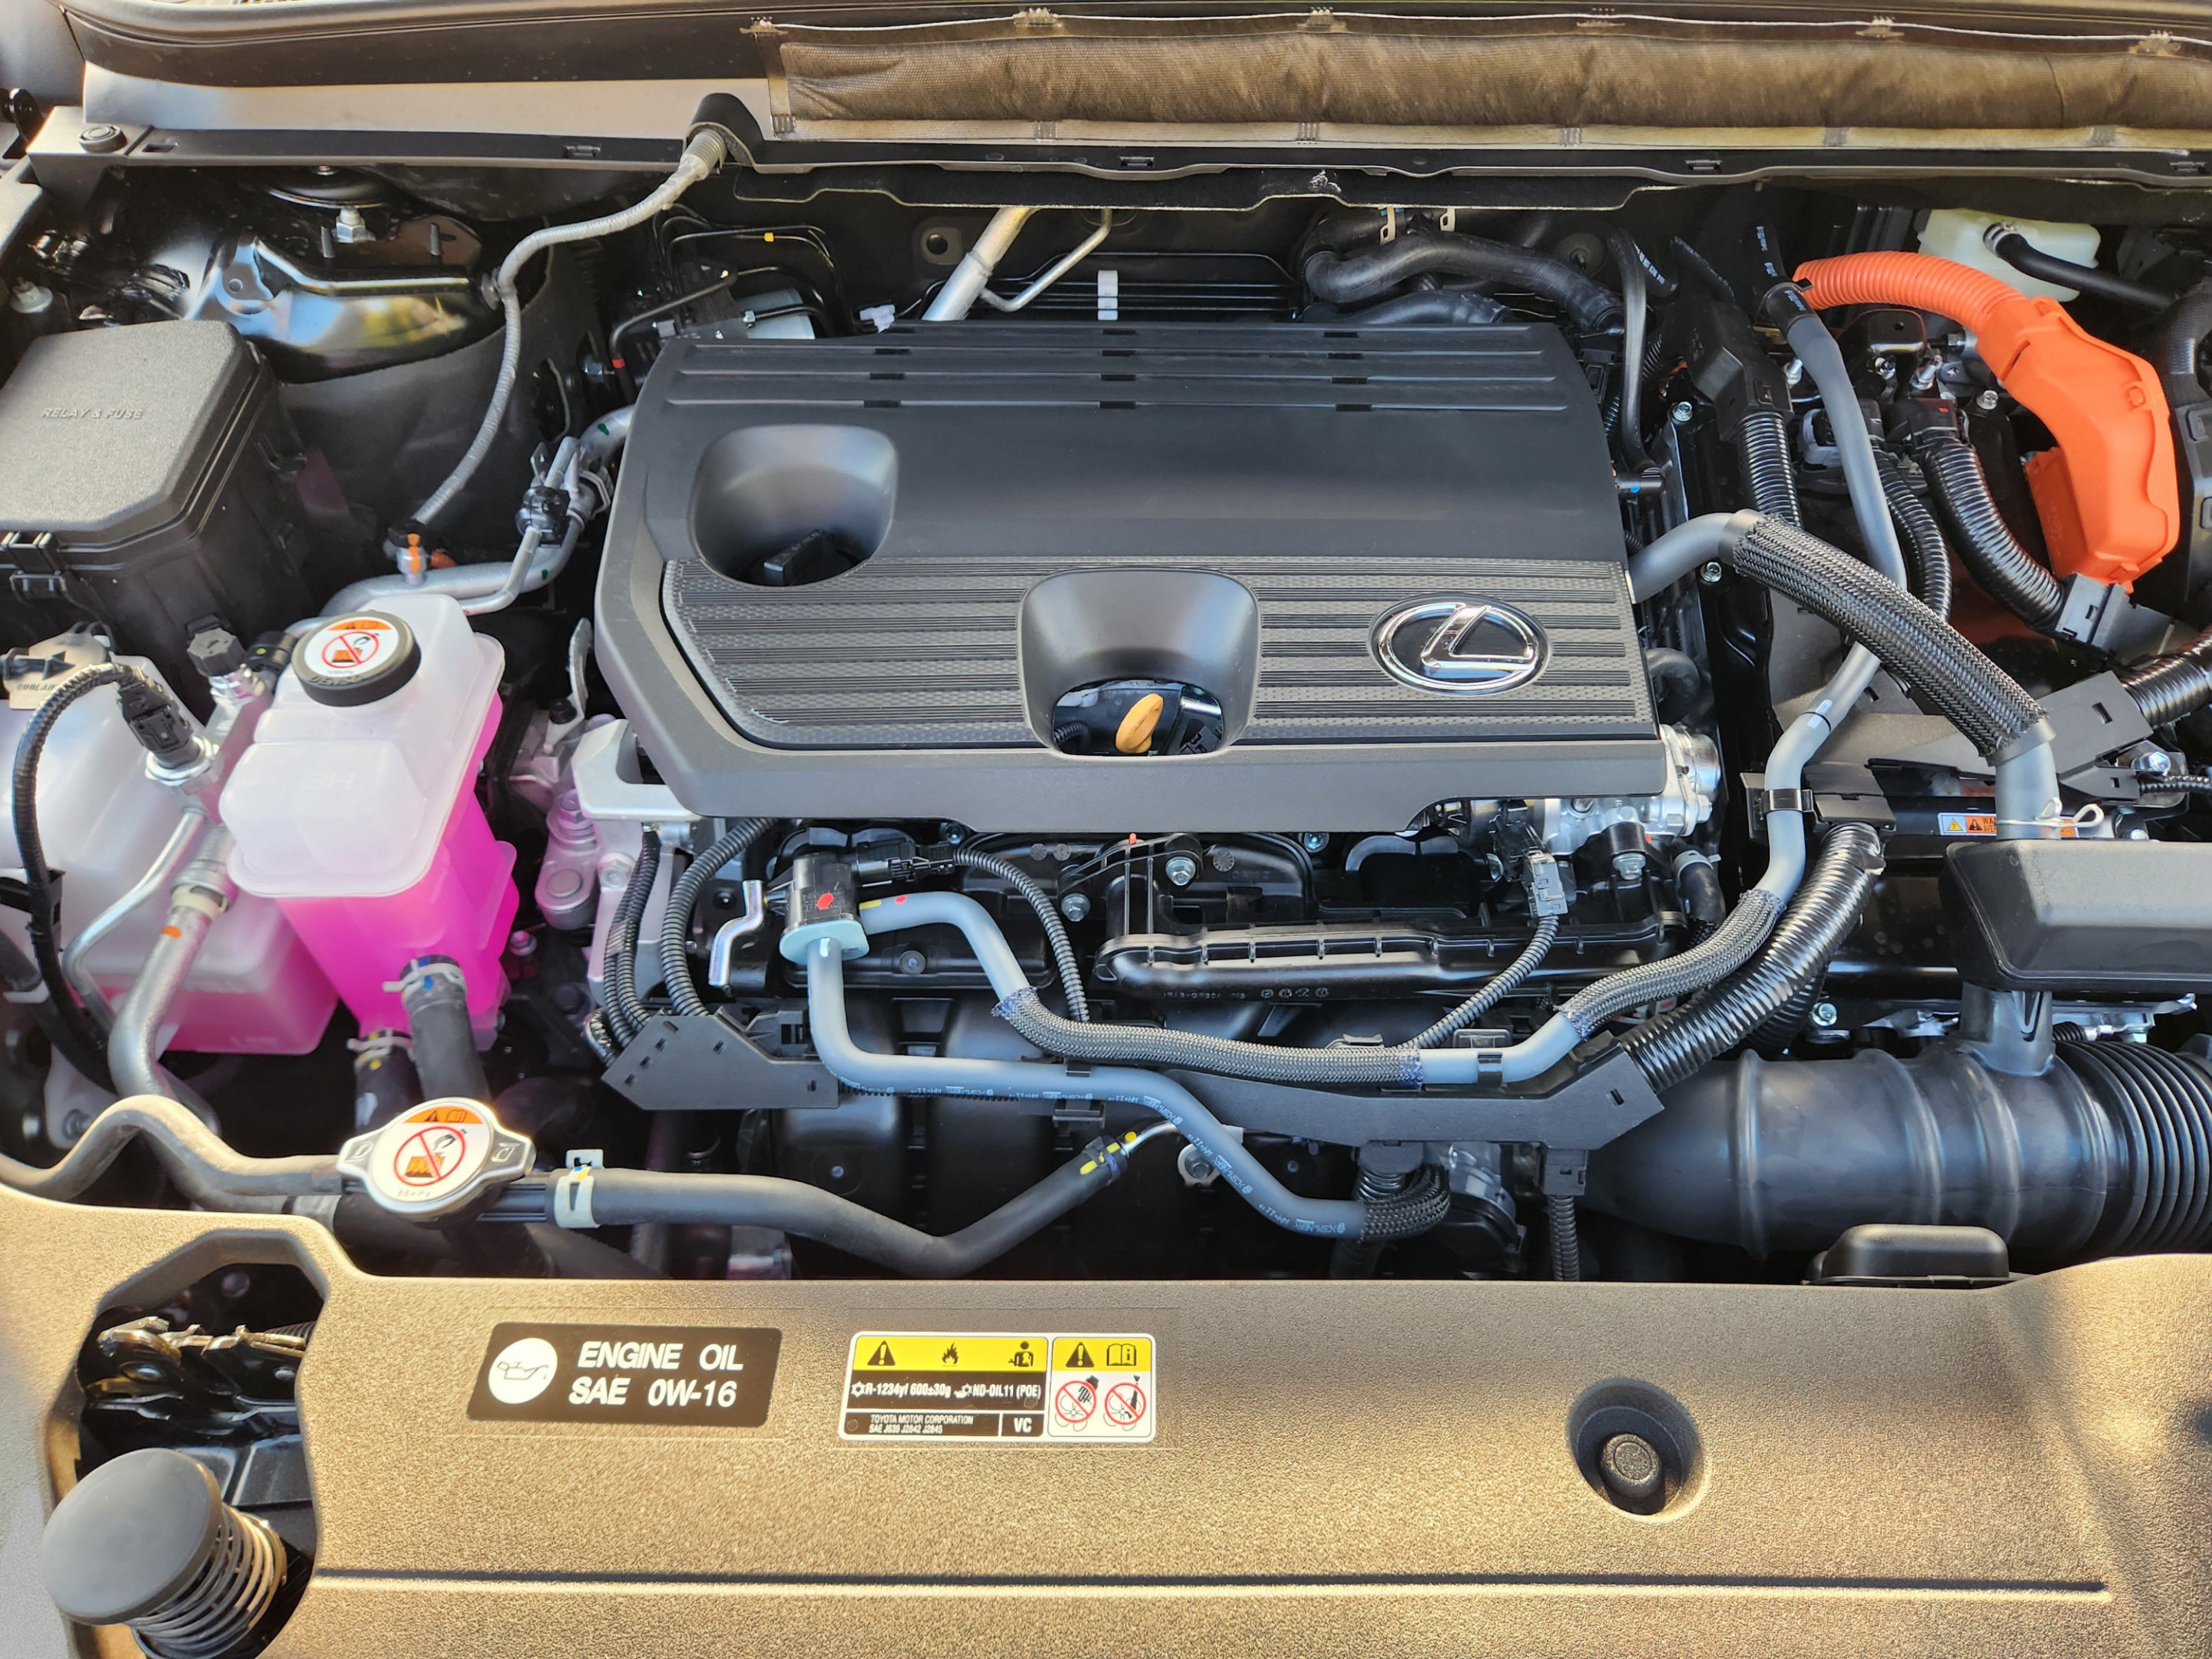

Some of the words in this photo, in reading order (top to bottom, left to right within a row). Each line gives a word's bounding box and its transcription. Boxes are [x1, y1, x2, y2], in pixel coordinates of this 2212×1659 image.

[42, 407, 91, 419] RELAY
[91, 408, 102, 419] &
[105, 408, 144, 420] FUSE
[17, 683, 58, 691] COOLAN
[577, 1341, 683, 1370] ENGINE
[699, 1343, 743, 1371] OIL
[568, 1376, 631, 1406] SAE
[647, 1379, 737, 1407] 0W-16
[865, 1382, 909, 1398] R-1234yf
[910, 1383, 952, 1398] 600±30g
[972, 1383, 1014, 1397] ND-OIL11
[1016, 1384, 1041, 1400] (POE)
[870, 1414, 897, 1424] TOYOTA
[898, 1415, 923, 1424] MOTOR
[924, 1415, 974, 1425] CORPORATION
[1014, 1417, 1032, 1433] VC
[869, 1423, 883, 1433] SAE
[901, 1425, 922, 1434] J2842
[922, 1425, 943, 1435] J2845
